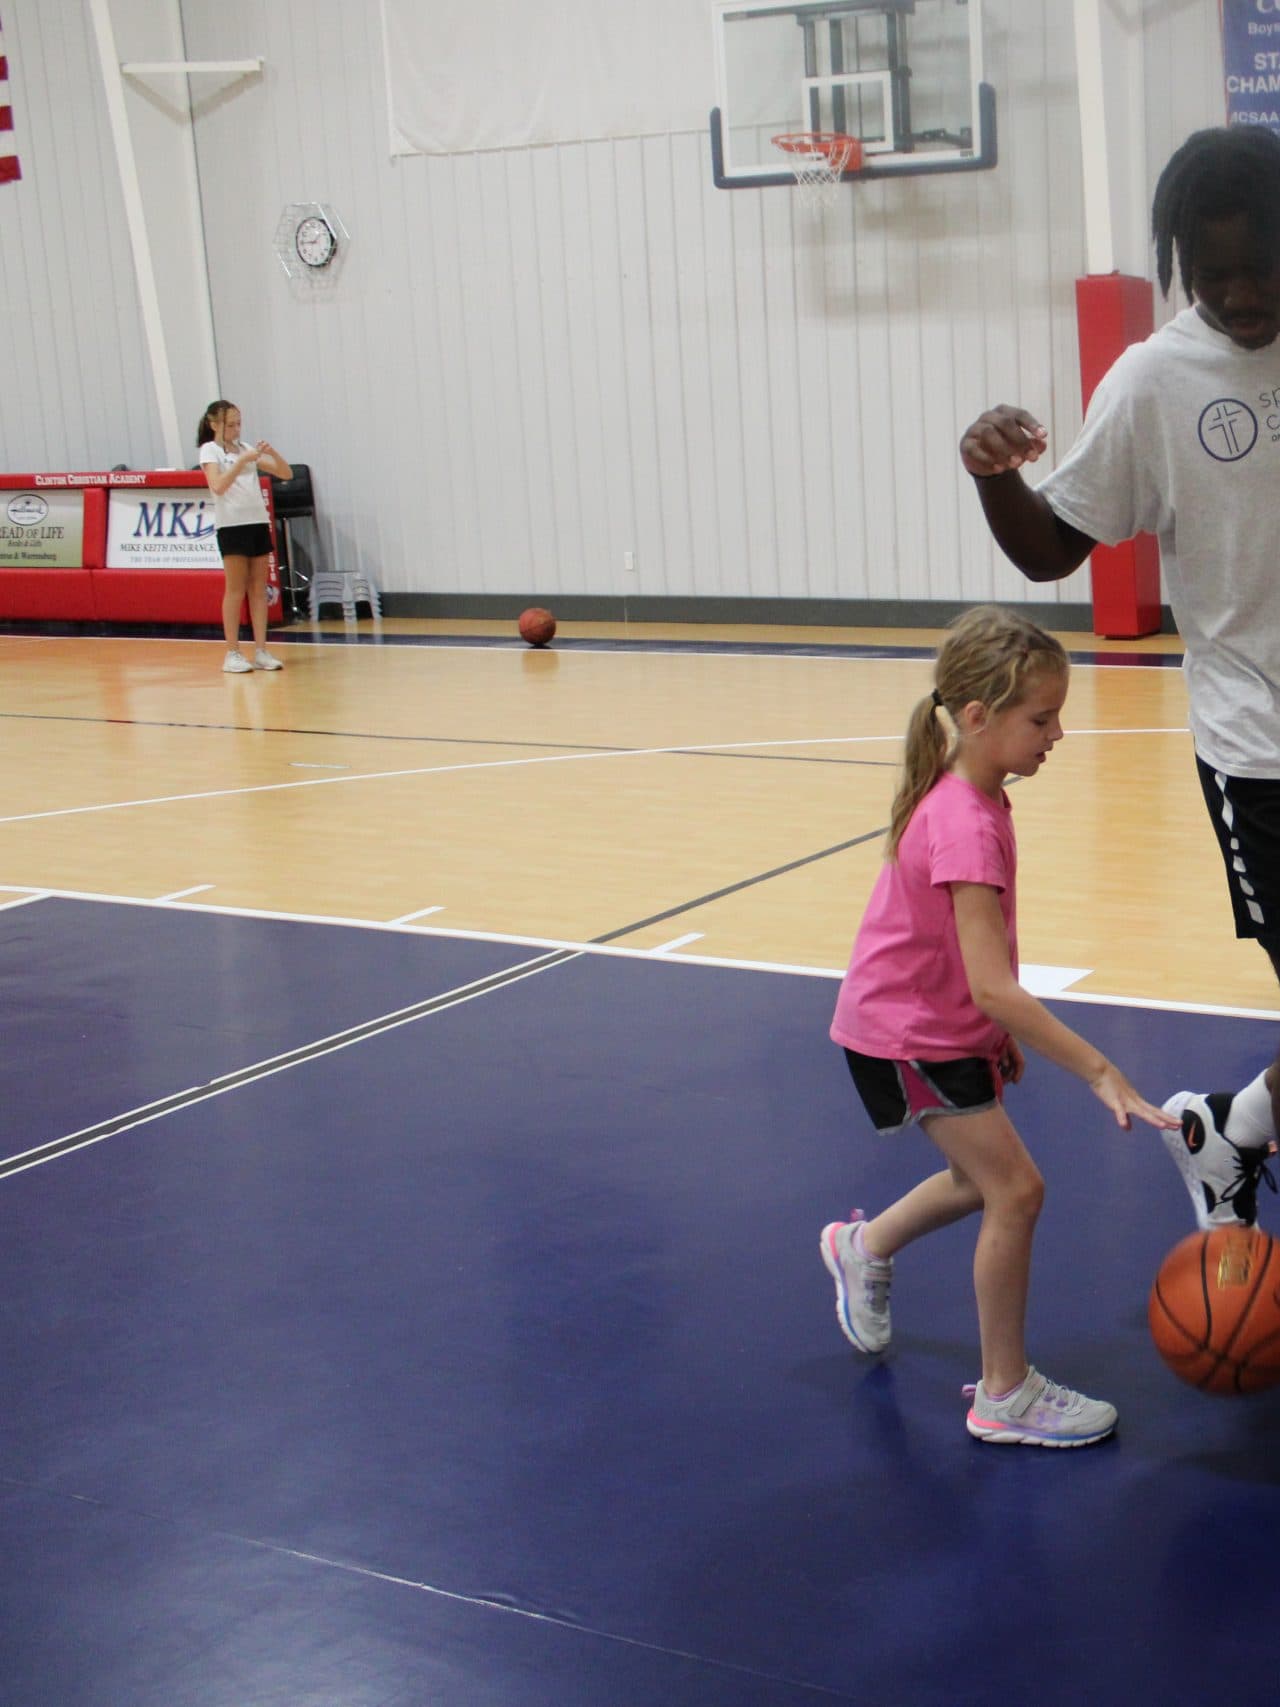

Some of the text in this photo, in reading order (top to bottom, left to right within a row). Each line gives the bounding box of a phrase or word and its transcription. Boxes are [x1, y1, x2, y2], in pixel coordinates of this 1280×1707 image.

[1247, 22, 1280, 37] Boys
[35, 473, 146, 485] CLINTON CHRISTIAN ACADEMY
[26, 528, 39, 539] OF
[41, 527, 64, 539] LIFE
[120, 544, 141, 552] MIKE
[142, 544, 168, 552] KEITH
